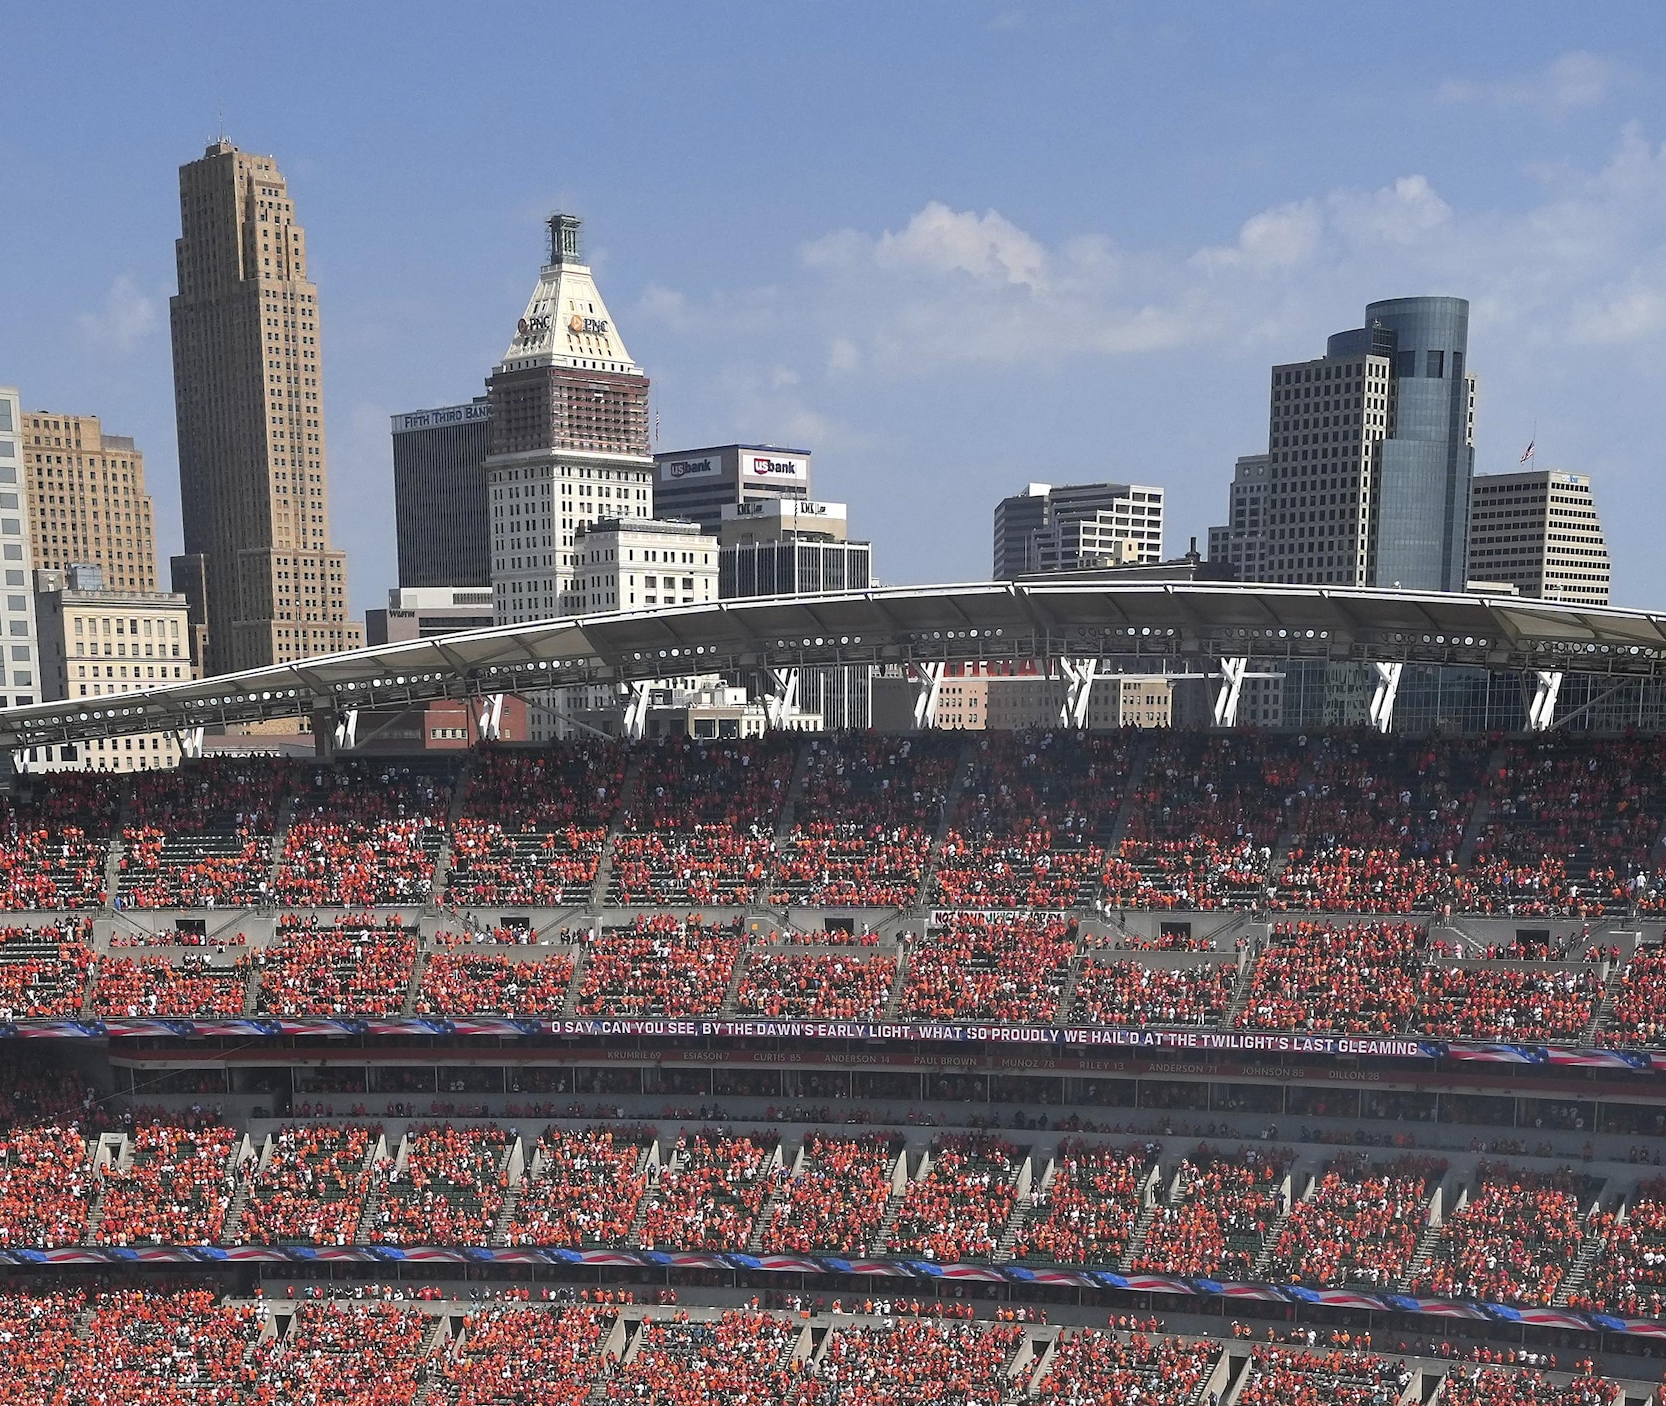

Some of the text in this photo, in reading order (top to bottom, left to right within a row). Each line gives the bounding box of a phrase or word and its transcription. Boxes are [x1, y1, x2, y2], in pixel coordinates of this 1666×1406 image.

[529, 316, 550, 330] PNC
[584, 318, 609, 332] PNC
[405, 415, 430, 428] FIFTH
[432, 411, 463, 424] THIRD
[552, 1022, 560, 1033] O
[603, 1022, 631, 1033] CAN
[636, 1022, 664, 1033] YOU
[668, 1022, 698, 1035] SEE,
[703, 1023, 721, 1034] BY
[726, 1023, 753, 1035] THE
[757, 1023, 814, 1035] DAWN'S
[818, 1024, 865, 1036] EARLY
[869, 1025, 912, 1038] LIGHT,
[919, 1025, 962, 1038] WHAT
[967, 1027, 987, 1039] SO
[991, 1028, 1060, 1042] PROUDLY
[1064, 1030, 1087, 1042] WE
[1092, 1031, 1139, 1044] HAIL'D
[1144, 1033, 1163, 1045] AT
[1168, 1034, 1197, 1046] THE
[1202, 1034, 1288, 1049] TWILIGHT'S
[1293, 1038, 1333, 1051] LAST
[1339, 1040, 1418, 1055] GLEAMING
[607, 1052, 661, 1060] KRUMRIE 69
[683, 1052, 730, 1061] ESIASON 7
[753, 1053, 801, 1062] CURTIS 85
[824, 1055, 877, 1064] ANDERSON
[914, 1056, 977, 1066] PAUL BROWN
[1043, 1060, 1055, 1068] 78
[1079, 1061, 1109, 1070] RILEY
[1149, 1063, 1203, 1073] ANDERSON
[1242, 1067, 1290, 1077] JOHNSON
[1329, 1070, 1380, 1080] DILLON 28
